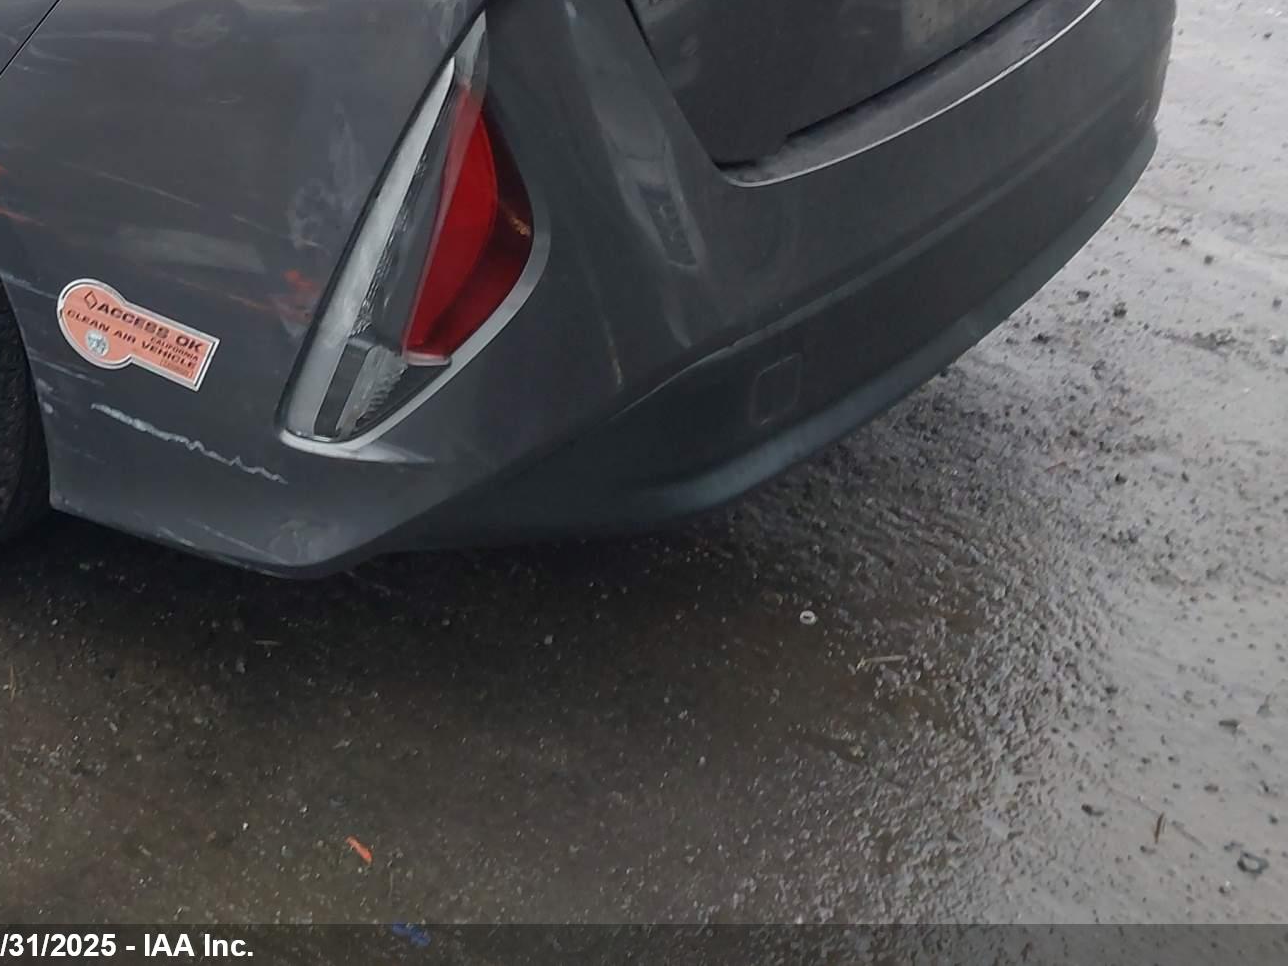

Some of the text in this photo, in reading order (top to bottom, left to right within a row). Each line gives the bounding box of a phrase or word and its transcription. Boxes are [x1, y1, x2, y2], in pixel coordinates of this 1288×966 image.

[66, 309, 110, 333] CLEAN
[114, 330, 137, 345] AIR
[141, 341, 198, 369] VEHICLE
[97, 303, 203, 353] ACCESS OK
[150, 337, 199, 362] CALIFORNIA
